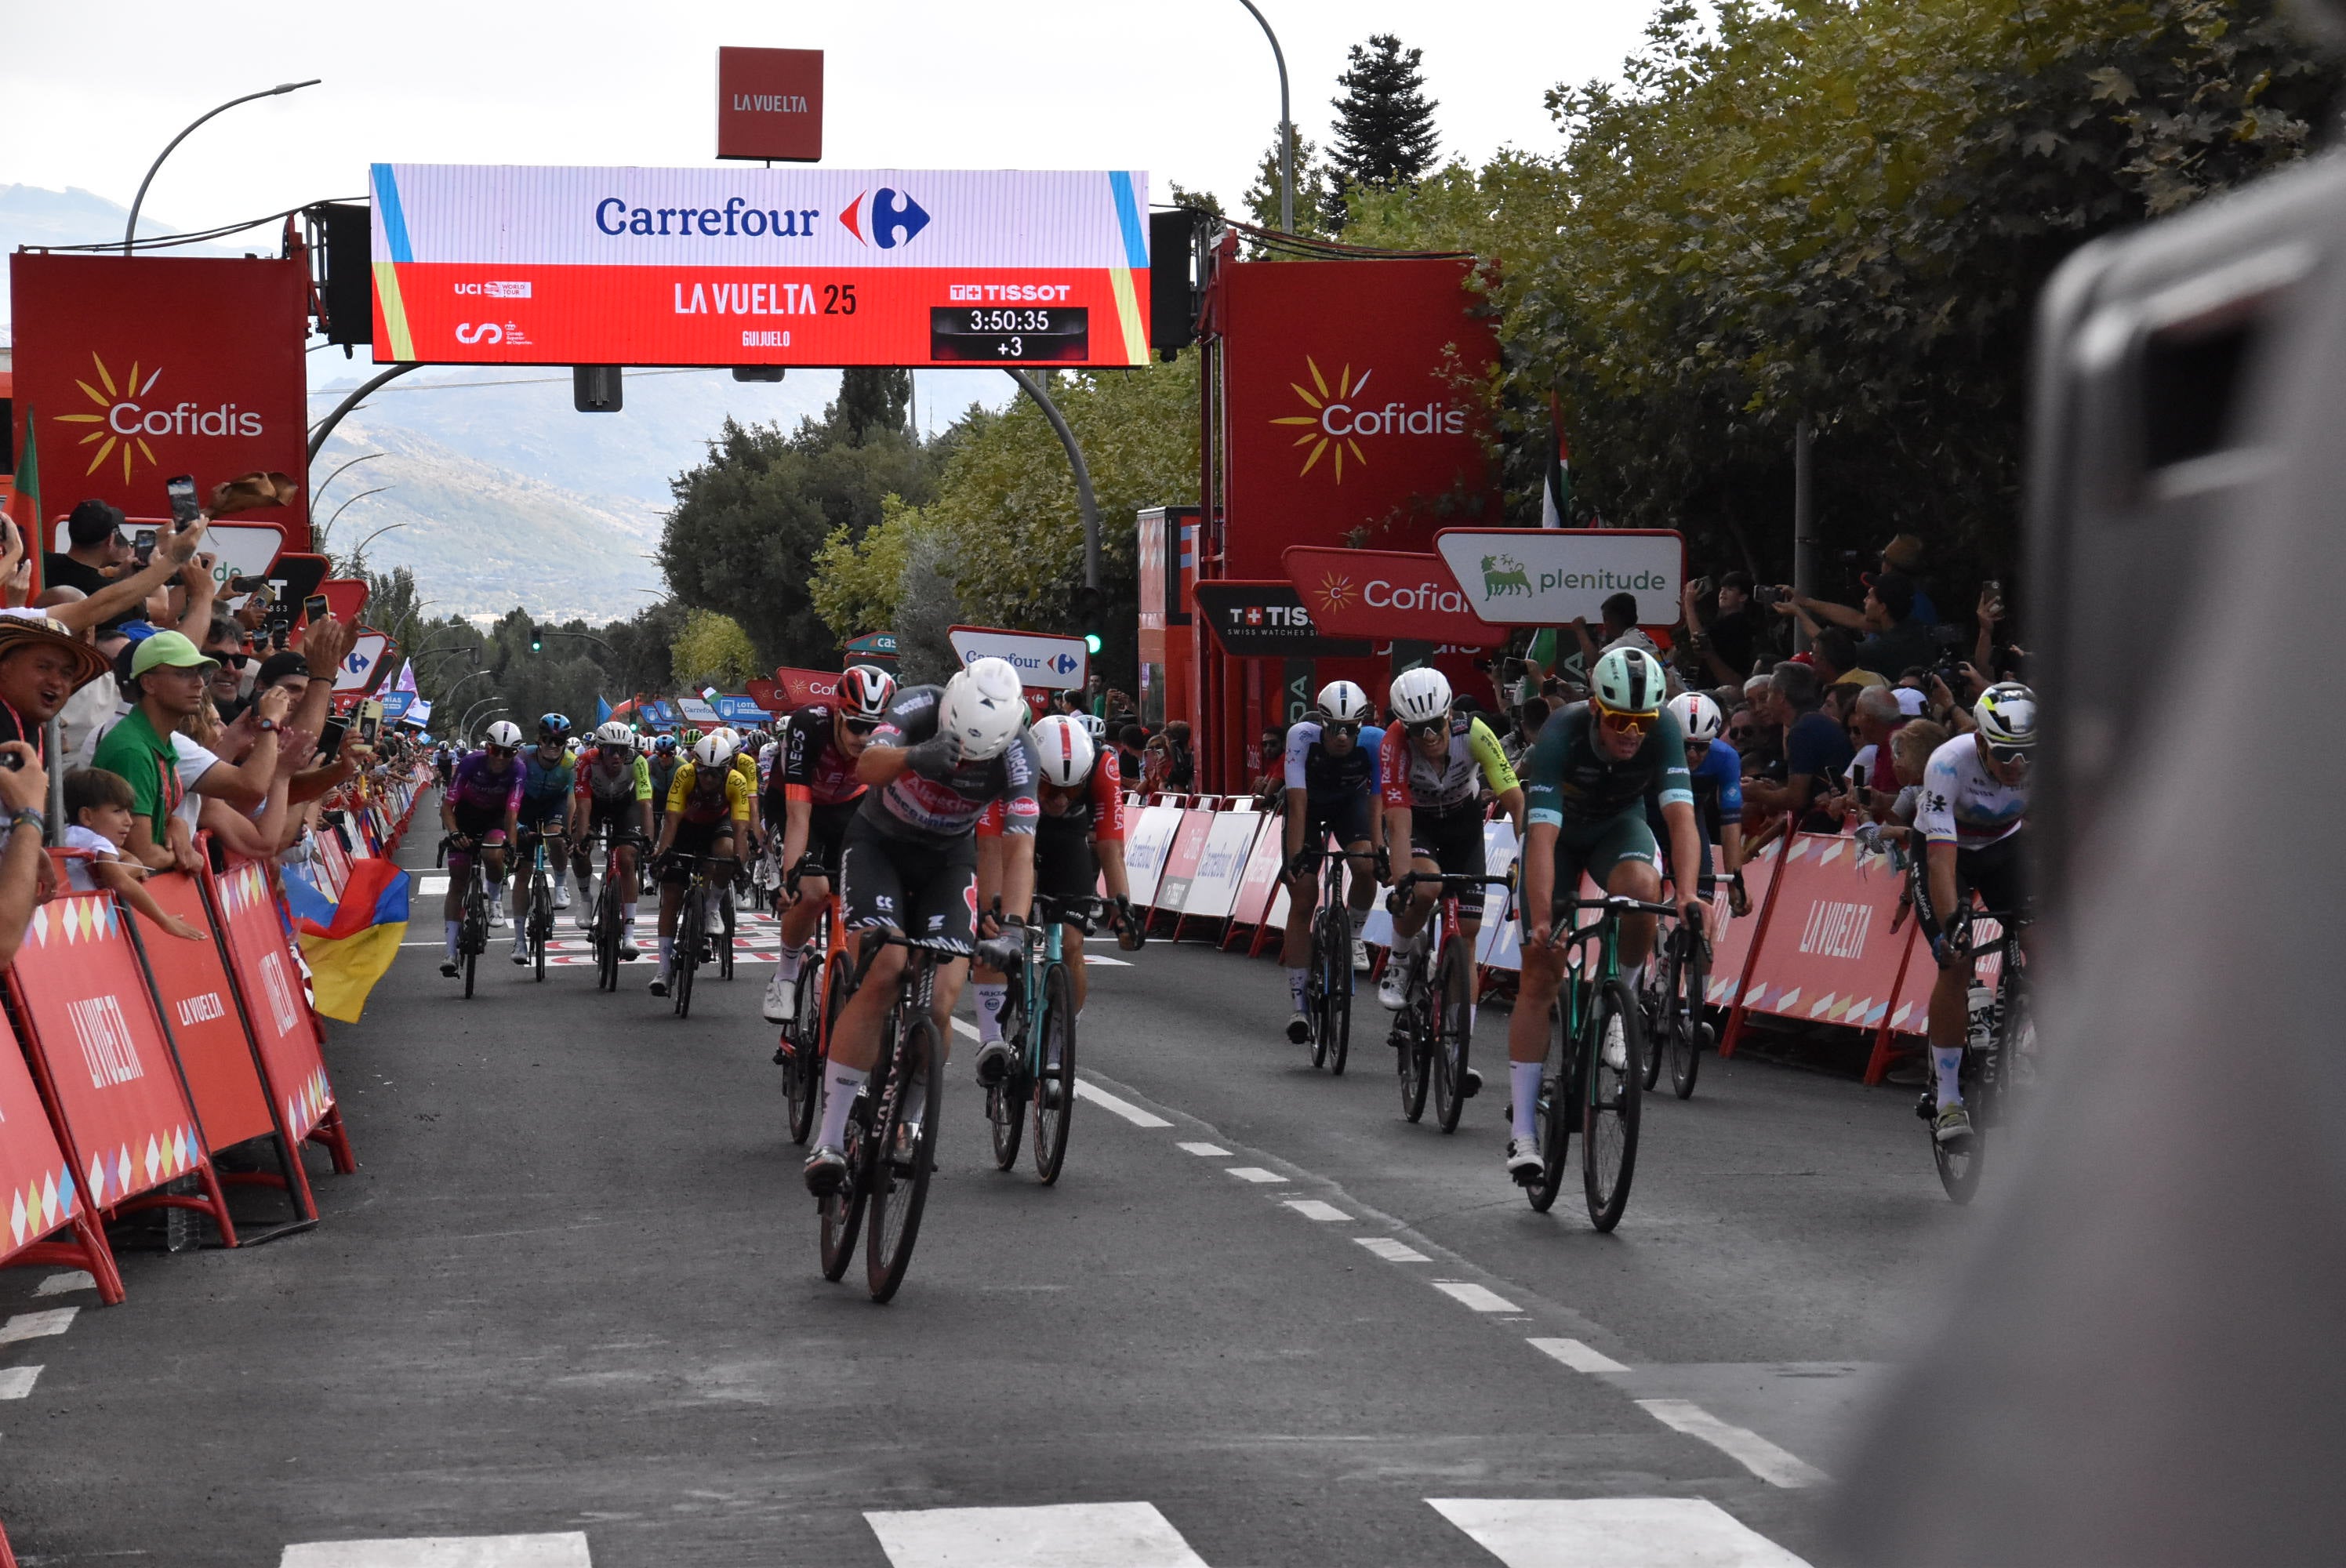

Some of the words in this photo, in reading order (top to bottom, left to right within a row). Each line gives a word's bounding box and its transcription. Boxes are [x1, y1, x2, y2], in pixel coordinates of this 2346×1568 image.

[733, 93, 752, 111] LA
[754, 94, 808, 113] VUELTA
[595, 197, 819, 238] Carrefour
[454, 283, 481, 295] UCI
[674, 282, 707, 314] LA
[712, 283, 817, 314] VUELTA
[823, 284, 857, 315] 25
[984, 285, 1070, 301] TISSOT
[970, 310, 1049, 331] 3:50:35
[742, 330, 790, 347] GUIJUELO
[997, 336, 1022, 357] +3
[109, 402, 263, 436] Cofidis
[1322, 402, 1465, 435] Cofidis
[1540, 568, 1665, 593] plenitude
[268, 604, 289, 613] 853
[1266, 606, 1315, 626] TIS
[965, 650, 1041, 669] Cfour
[684, 706, 714, 714] Carrefou
[788, 728, 806, 775] INEOS
[1006, 739, 1033, 786] Alpecin
[1114, 786, 1124, 831] ARKEA
[1799, 899, 1826, 954] LA
[1822, 900, 1873, 960] VUELTA
[176, 1000, 193, 1026] LA
[187, 992, 226, 1023] VUELTA
